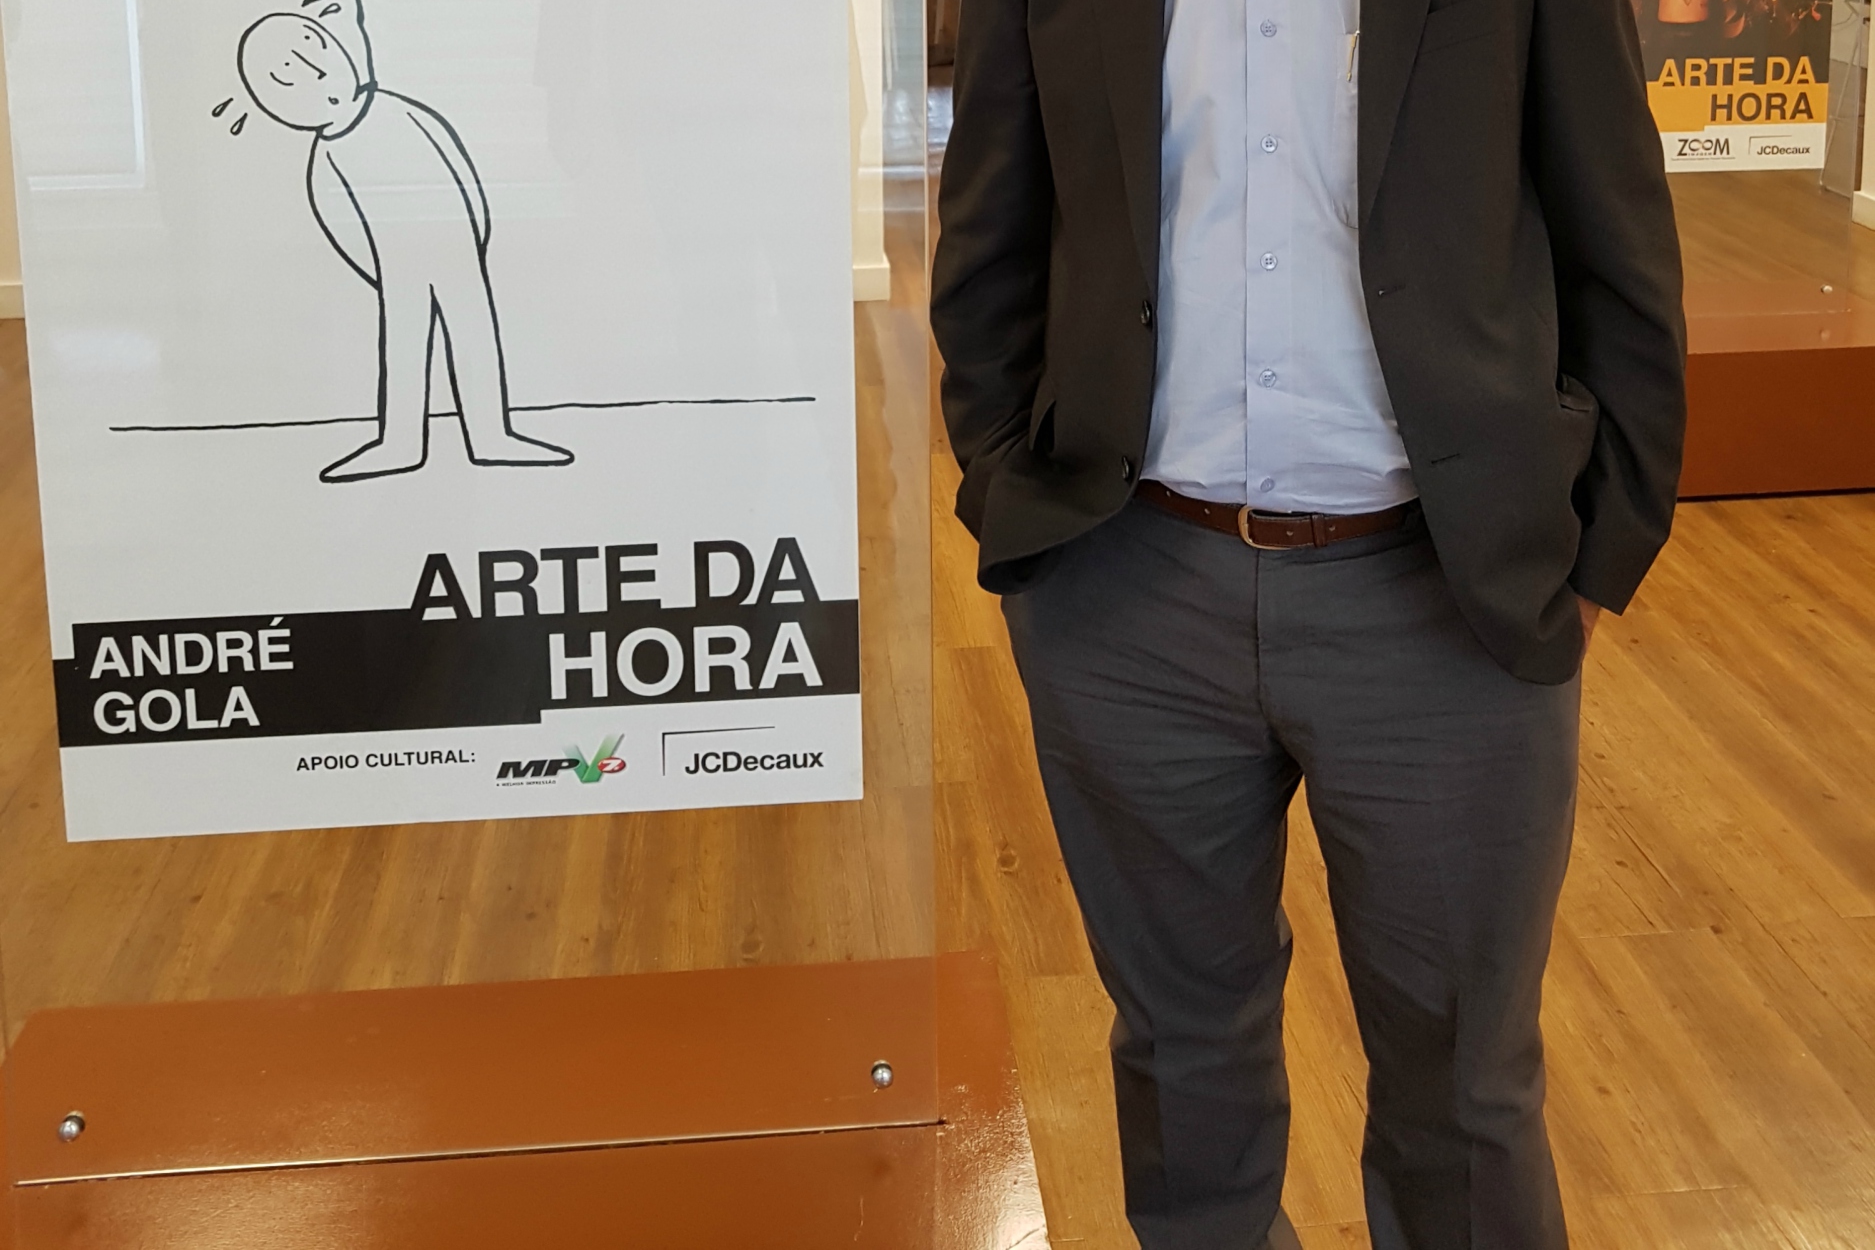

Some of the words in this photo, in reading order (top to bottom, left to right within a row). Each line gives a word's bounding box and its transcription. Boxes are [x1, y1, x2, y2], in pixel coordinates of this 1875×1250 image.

[1658, 58, 1754, 87] ARTE
[1767, 56, 1815, 84] DA
[1710, 92, 1814, 122] HORA
[1677, 138, 1730, 157] ZOOM
[1757, 145, 1811, 156] JCDecaux
[410, 544, 662, 621] ARTE
[693, 537, 822, 607] DA
[89, 617, 294, 679] ANDRÉ
[550, 621, 823, 700] HORA
[93, 687, 260, 734] GOLA
[296, 753, 359, 771] APOIO
[366, 748, 476, 768] CULTURAL:
[684, 751, 824, 775] JCDecaux
